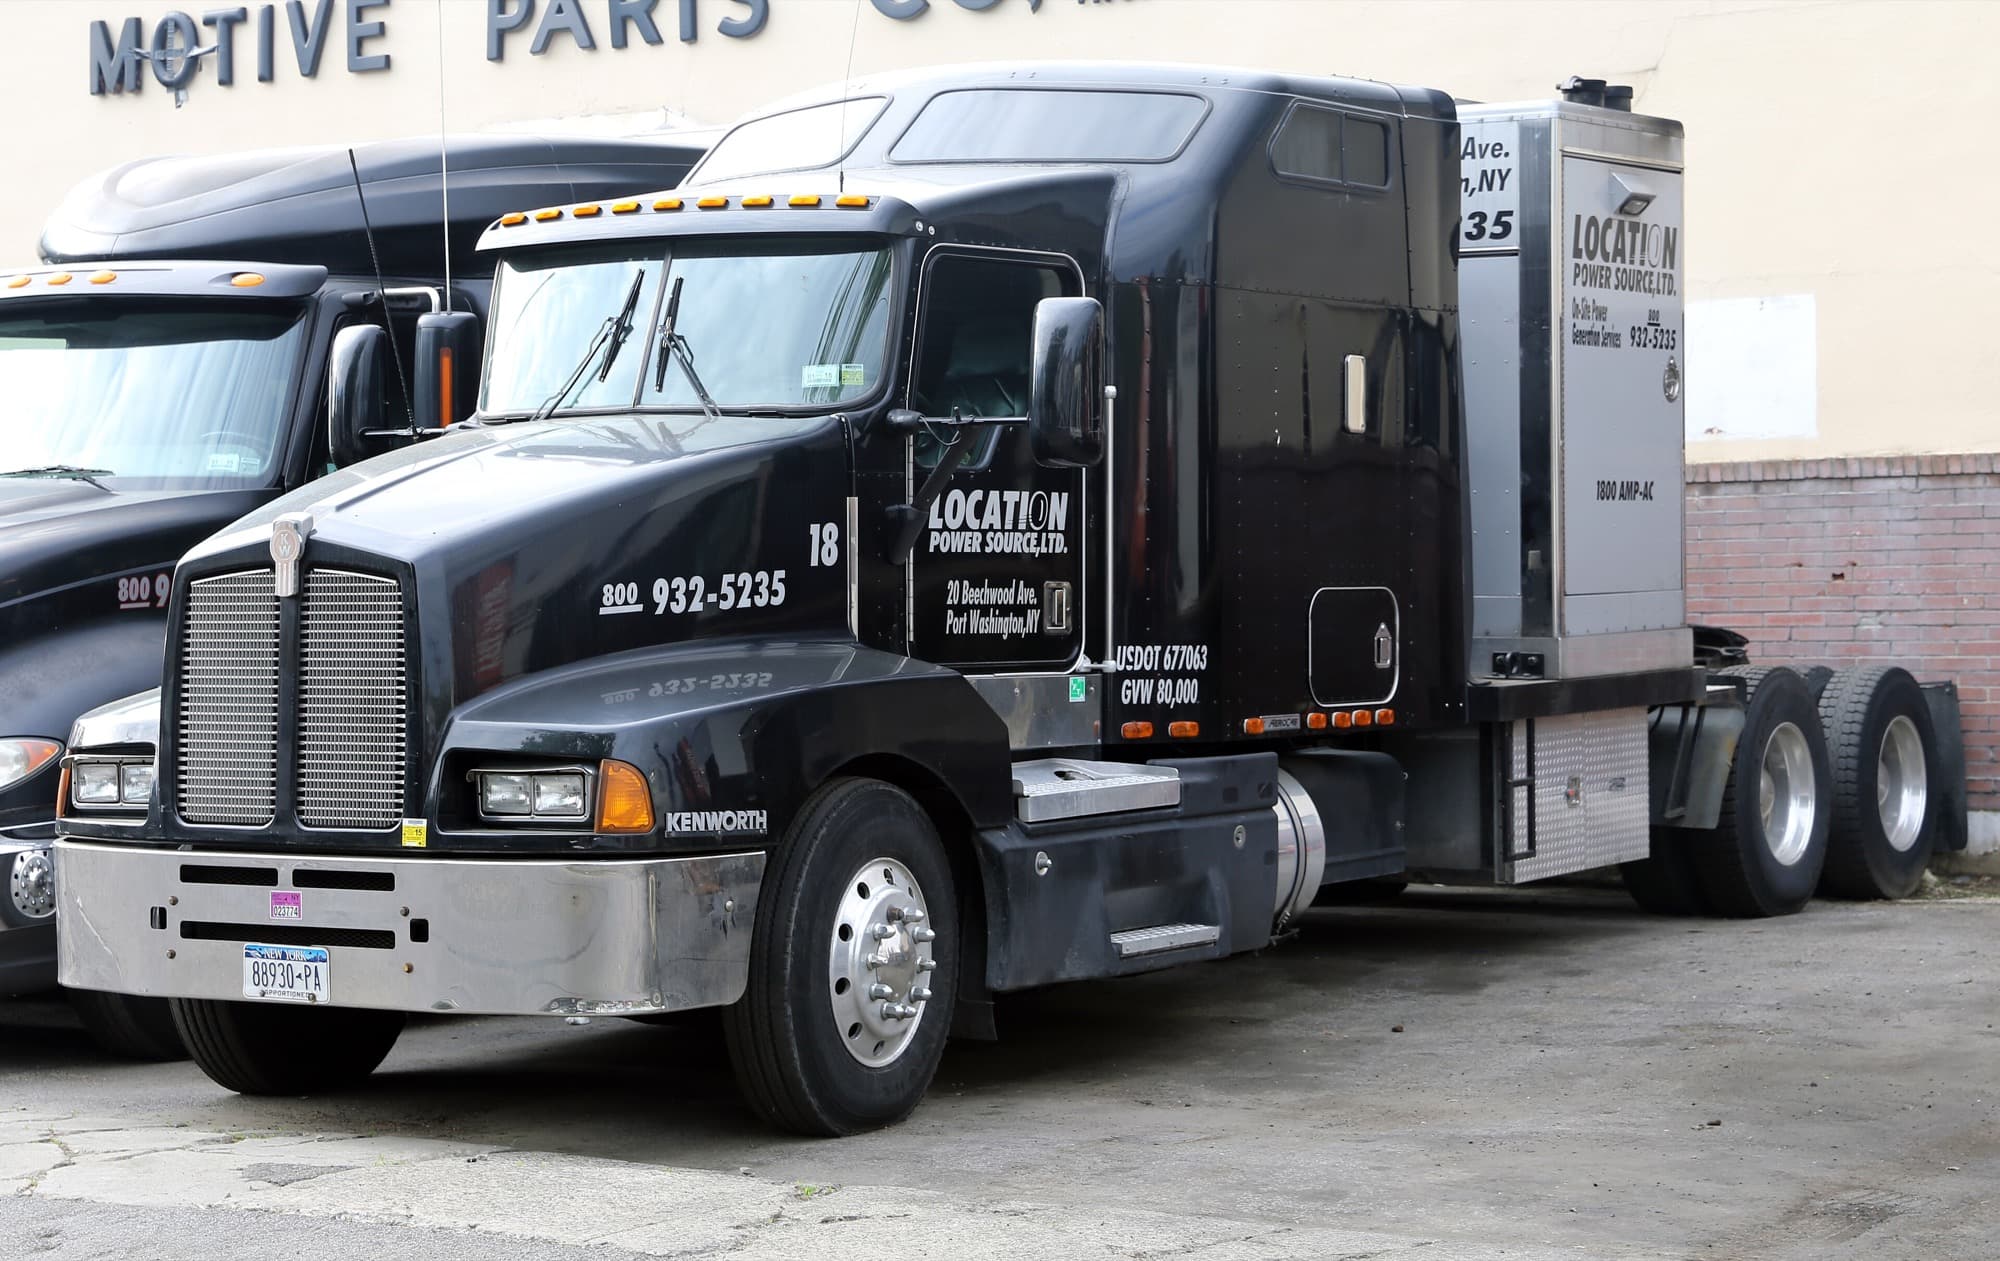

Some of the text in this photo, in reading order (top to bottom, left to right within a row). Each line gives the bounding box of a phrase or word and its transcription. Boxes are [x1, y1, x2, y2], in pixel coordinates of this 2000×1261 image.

[90, 0, 391, 95] MOTIVE
[1461, 136, 1510, 160] Ave.
[1460, 209, 1514, 241] 35
[1572, 214, 1678, 270] LOCATION
[1573, 262, 1612, 289] POWER
[1592, 298, 1608, 322] Power
[1648, 309, 1661, 322] 800
[1630, 325, 1677, 350] 932-5235
[1596, 480, 1654, 501] 1800 AMP-AC
[928, 488, 1069, 531] LOCATION
[809, 522, 839, 567] 18
[929, 531, 1068, 558] POWER SOURCE,LTD.
[118, 576, 150, 602] 800
[602, 569, 786, 615] 800 932-5235
[946, 578, 1037, 605] 20 Beechwood Ave.
[946, 607, 1040, 640] Port Washington,NY
[1116, 644, 1207, 671] USDOT 677063
[1121, 678, 1198, 709] GVW 80,000
[666, 810, 767, 832] KENWORTH
[264, 949, 307, 961] NEW YORK
